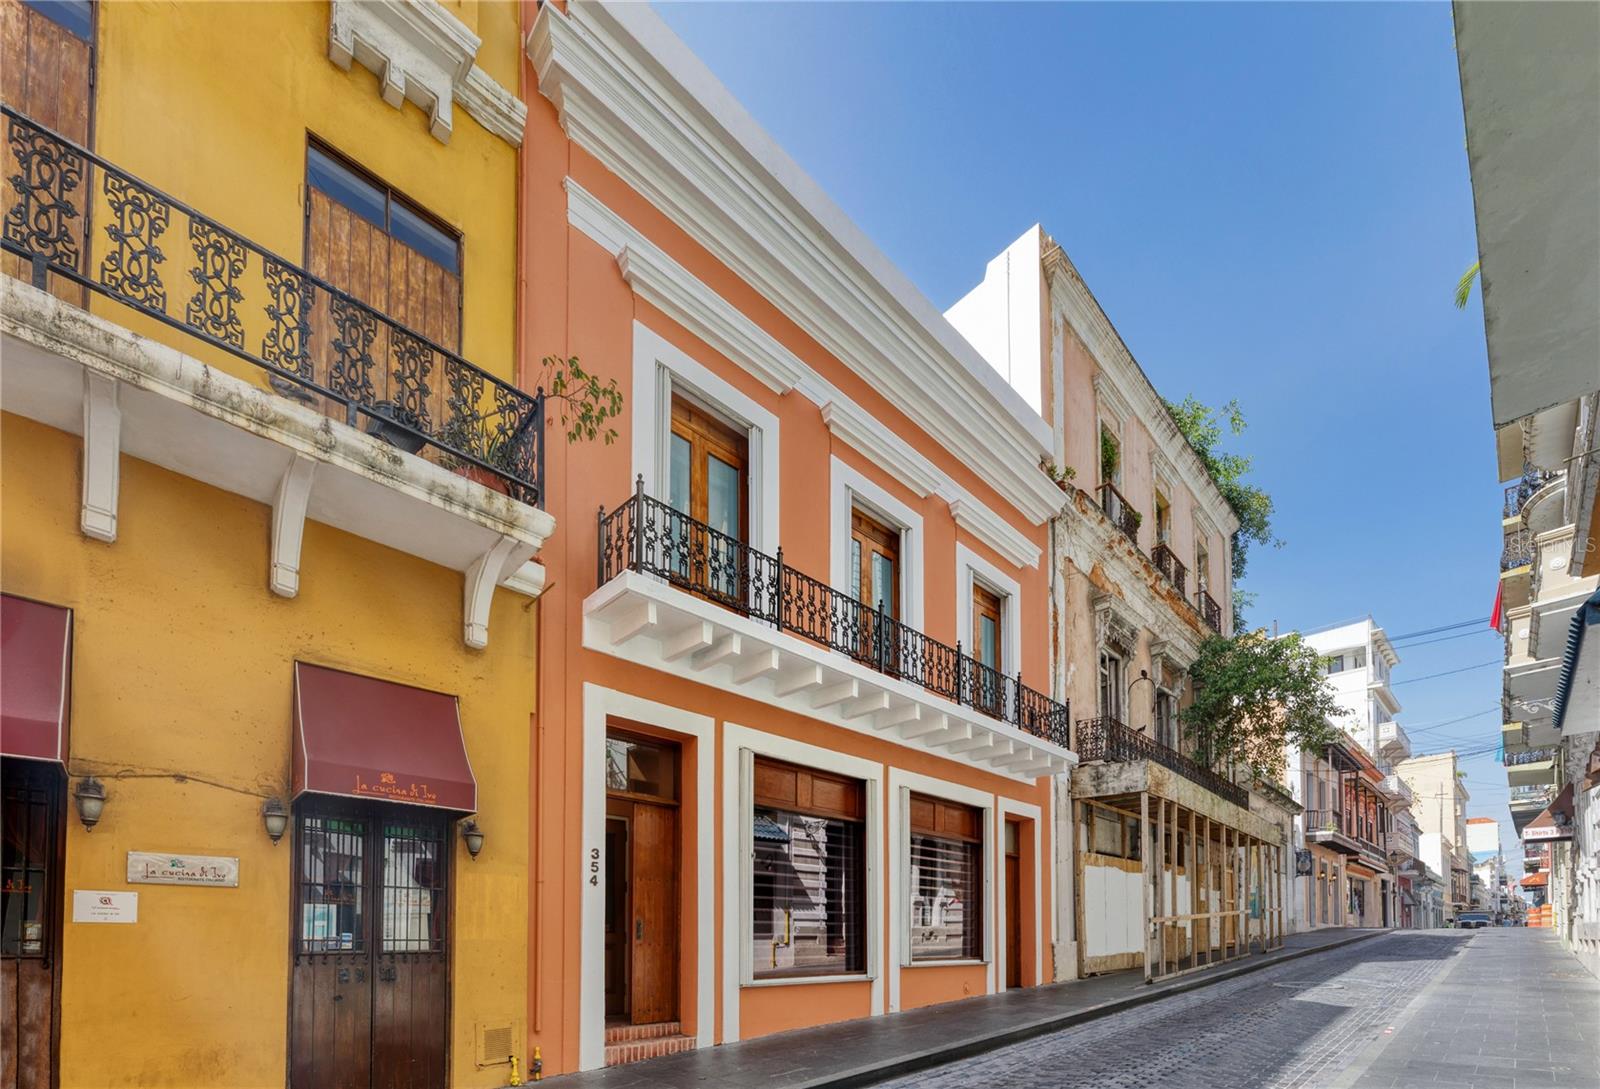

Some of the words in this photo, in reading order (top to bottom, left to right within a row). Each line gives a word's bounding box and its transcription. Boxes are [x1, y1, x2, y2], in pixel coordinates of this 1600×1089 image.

[372, 784, 407, 795] cucina
[589, 848, 600, 887] 354
[161, 869, 197, 878] cucina
